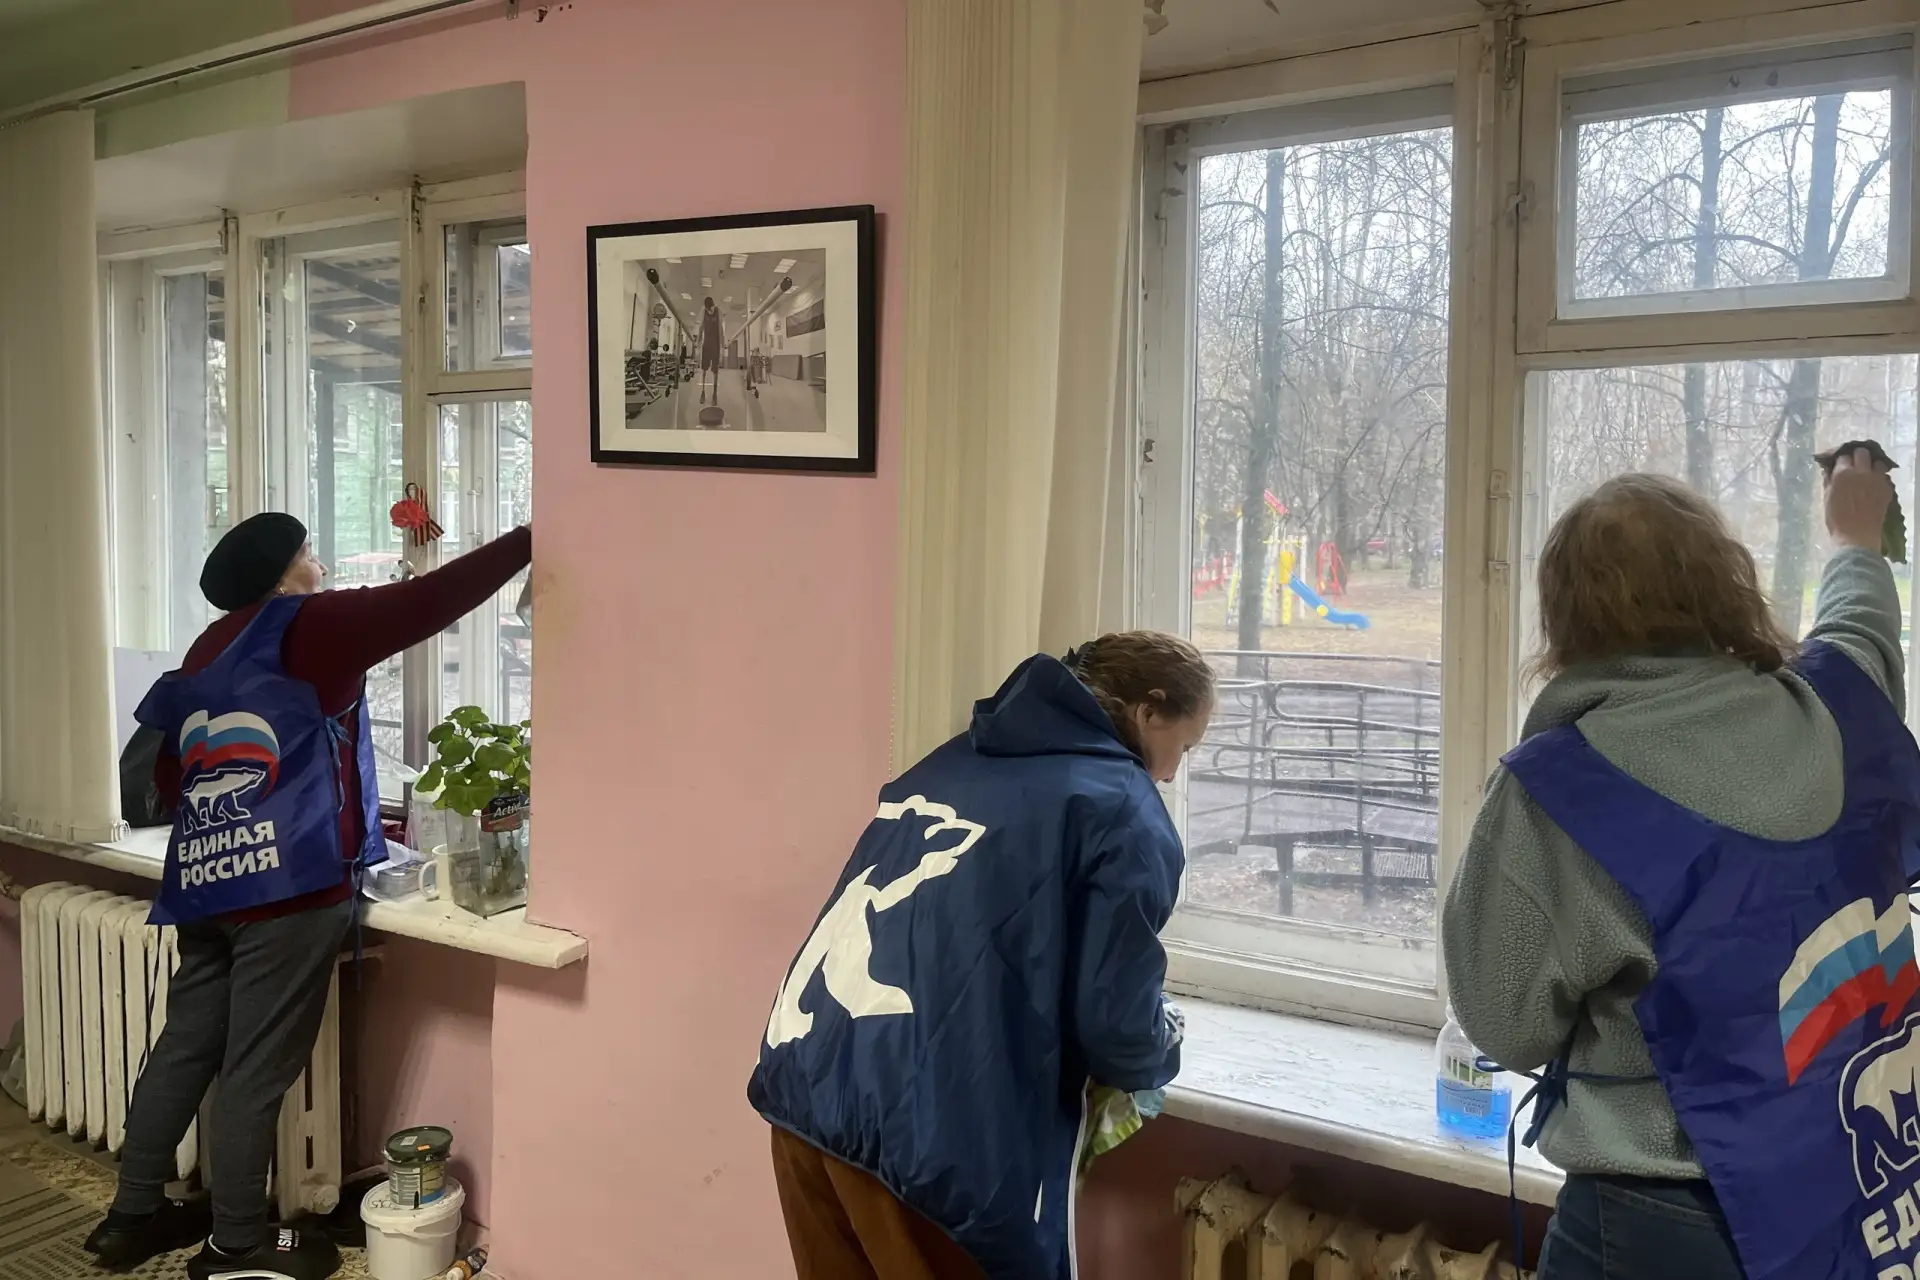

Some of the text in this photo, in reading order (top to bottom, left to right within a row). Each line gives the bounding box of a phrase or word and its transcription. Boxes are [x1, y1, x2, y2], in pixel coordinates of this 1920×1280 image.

[177, 820, 276, 864] ЕДИНАЯ
[180, 846, 280, 890] РОССИЯ
[1861, 1178, 1920, 1260] ЕД
